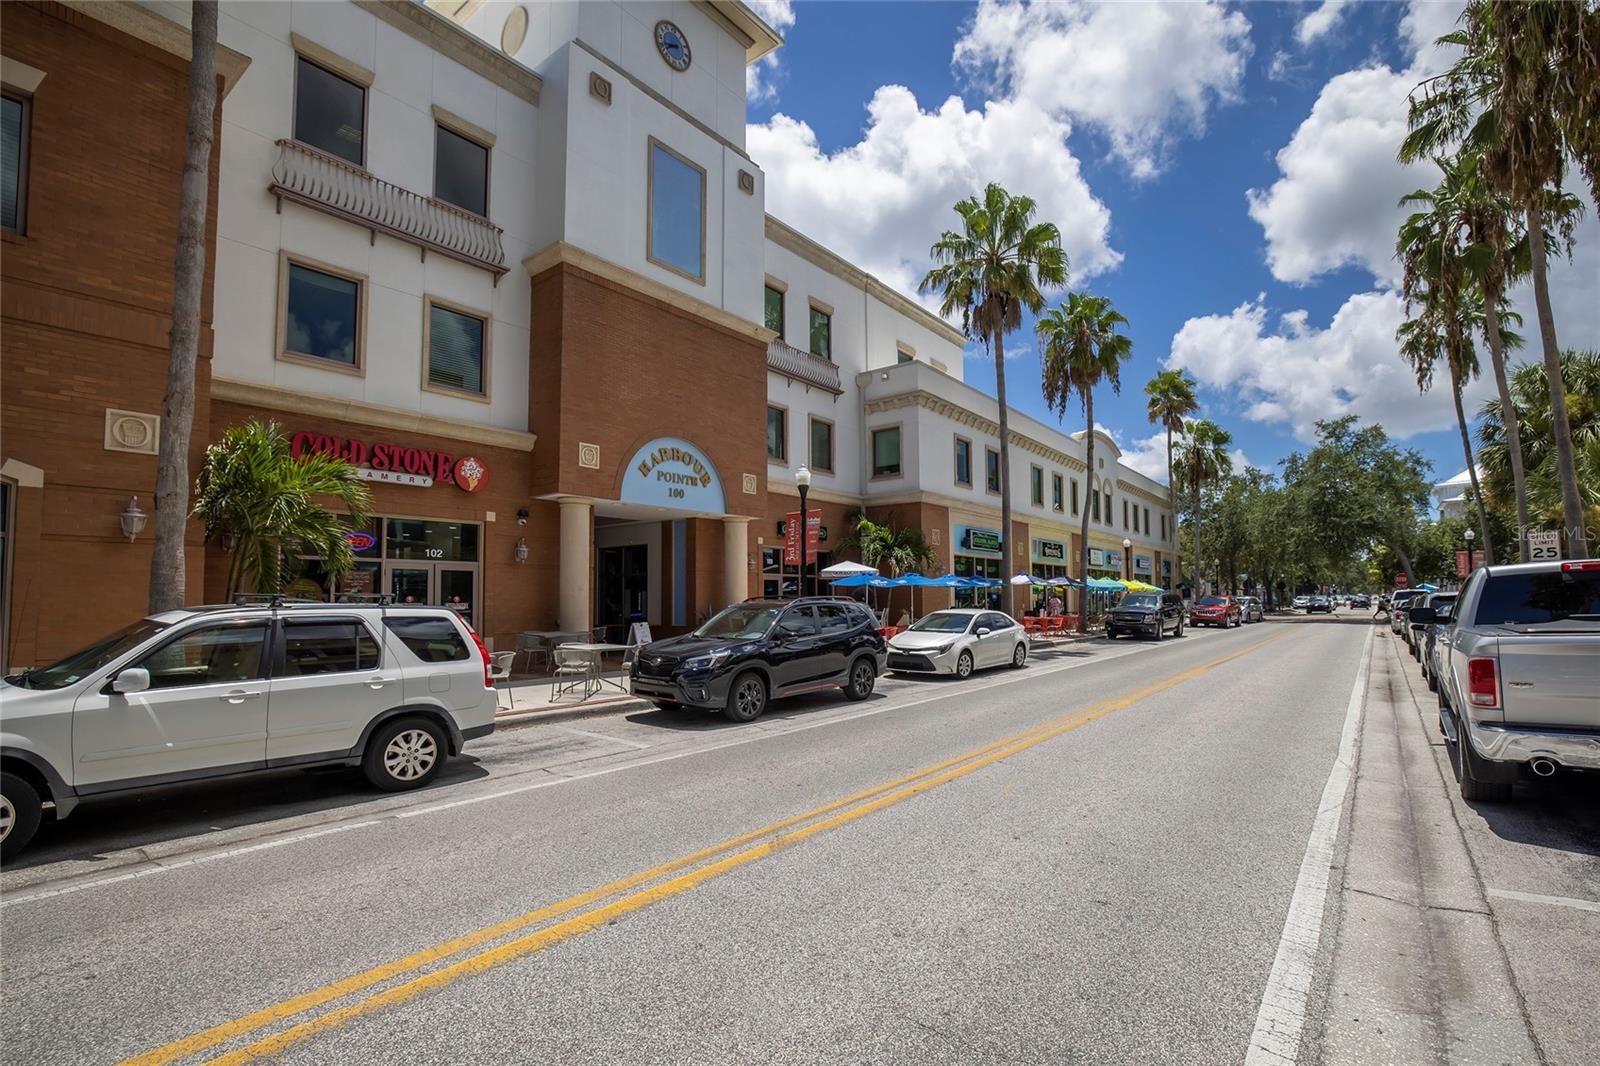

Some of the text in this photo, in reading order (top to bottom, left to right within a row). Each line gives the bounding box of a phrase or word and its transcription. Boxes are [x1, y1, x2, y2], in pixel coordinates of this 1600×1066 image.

[291, 431, 455, 484] COLD STONE
[638, 447, 711, 488] HARBOUR
[656, 470, 698, 487] POINTE
[668, 487, 685, 499] 100
[785, 518, 796, 561] 3rd Friday
[425, 549, 443, 558] 102
[1533, 547, 1558, 558] 25
